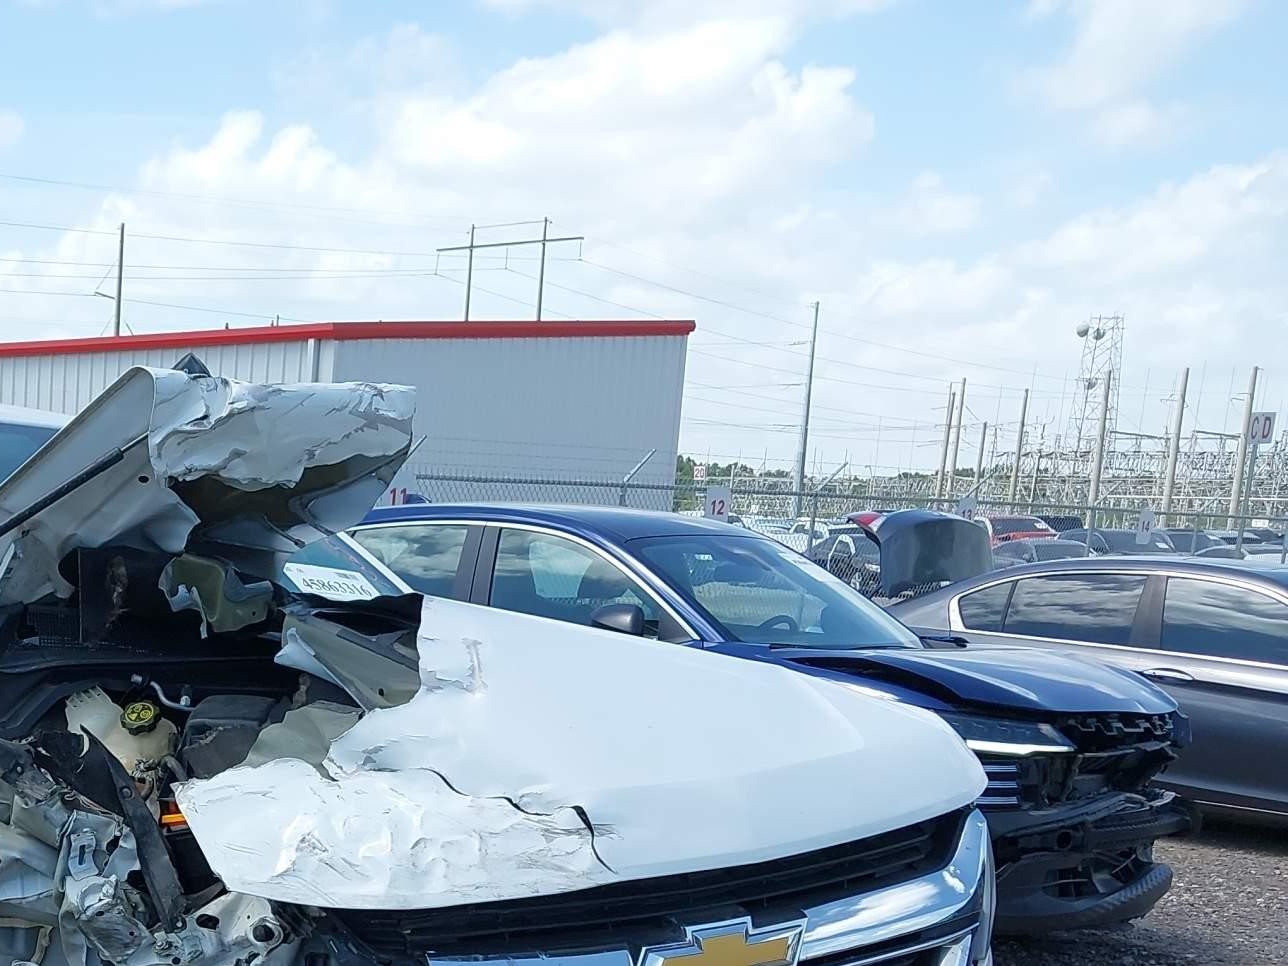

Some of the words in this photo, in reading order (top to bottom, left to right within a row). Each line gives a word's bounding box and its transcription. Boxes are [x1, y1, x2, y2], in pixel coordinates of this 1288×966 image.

[390, 487, 408, 506] 11
[711, 499, 725, 515] 12
[302, 577, 372, 597] 45863316
